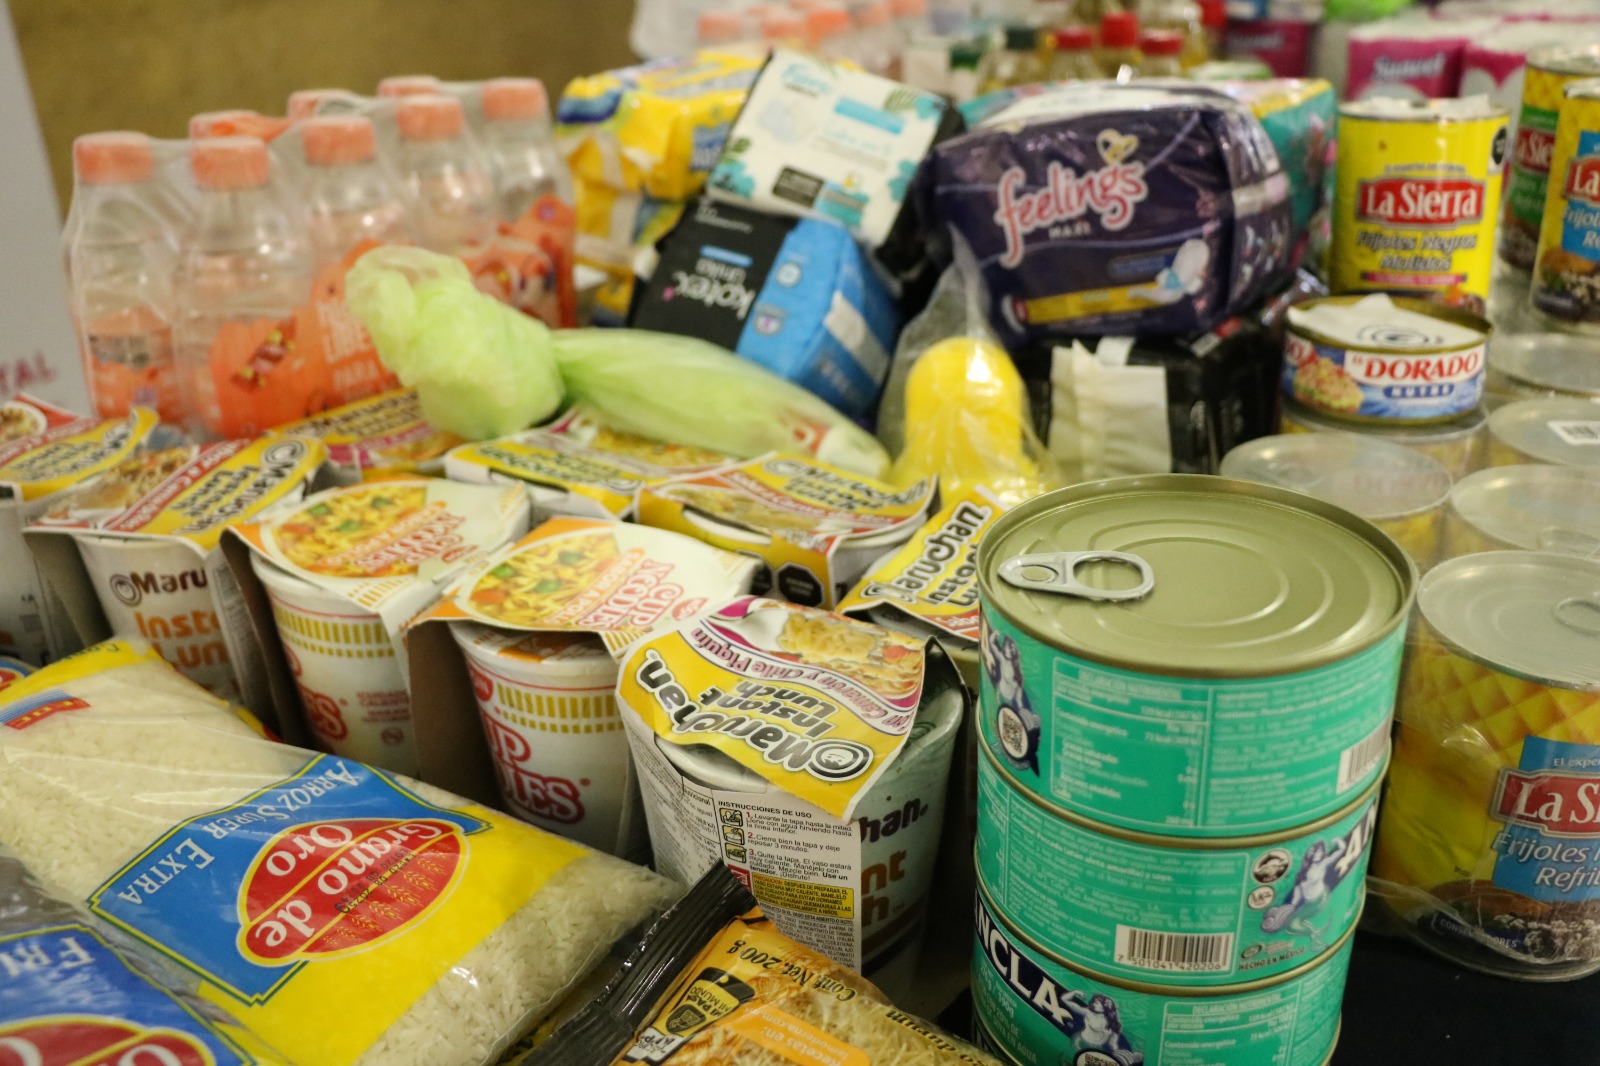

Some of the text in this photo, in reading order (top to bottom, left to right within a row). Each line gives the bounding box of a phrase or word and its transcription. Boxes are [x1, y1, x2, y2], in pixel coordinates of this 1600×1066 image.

[1572, 164, 1600, 196] La
[994, 160, 1148, 269] feelings
[1366, 184, 1395, 218] La
[1398, 181, 1479, 220] Sierra
[673, 270, 756, 321] kotex
[1363, 353, 1479, 381] DORADO
[896, 501, 989, 594] aruchan
[575, 559, 676, 628] NOODLES
[630, 582, 684, 626] CUP
[691, 627, 751, 672] Piquín
[751, 660, 804, 678] Chile
[699, 686, 835, 738] Instant
[736, 680, 838, 718] Lunch
[637, 656, 816, 772] Maruchan
[1553, 757, 1564, 766] El
[278, 760, 360, 813] ARROZ
[718, 801, 781, 815] INSTRUCCIONES
[1515, 781, 1561, 823] La
[754, 813, 780, 823] Levante
[789, 818, 803, 827] tapa
[780, 824, 798, 833] agua
[799, 825, 831, 835] hirviendo
[833, 828, 852, 837] hasta
[747, 839, 773, 848] reposar
[780, 844, 810, 853] minutos.
[756, 834, 777, 843] Cierre
[778, 837, 793, 845] bien
[802, 841, 818, 849] tapa
[826, 843, 840, 852] deje
[1491, 831, 1587, 864] Frijoles
[118, 838, 216, 906] EXTRA
[749, 860, 776, 870] cuidado.
[778, 864, 803, 874] Mezcle
[804, 867, 821, 876] bien.
[823, 871, 837, 879] Use
[750, 865, 778, 875] tenedor.
[757, 851, 776, 860] Quite
[784, 856, 801, 865] tapa.
[830, 862, 852, 871] estará
[763, 858, 791, 867] caliente.
[793, 862, 825, 873] Manéjelo
[255, 823, 444, 948] Grano de Oro
[727, 939, 747, 955] g
[738, 946, 779, 969] 200
[781, 960, 816, 989] Net.
[974, 905, 1074, 1026] NCLA
[1116, 953, 1222, 971] 7 501041 420206
[1238, 961, 1266, 972] HECHO
[1267, 957, 1278, 968] EN
[689, 985, 721, 1009] MUNDO
[815, 976, 858, 1003] Cont.
[885, 1007, 957, 1053] durum
